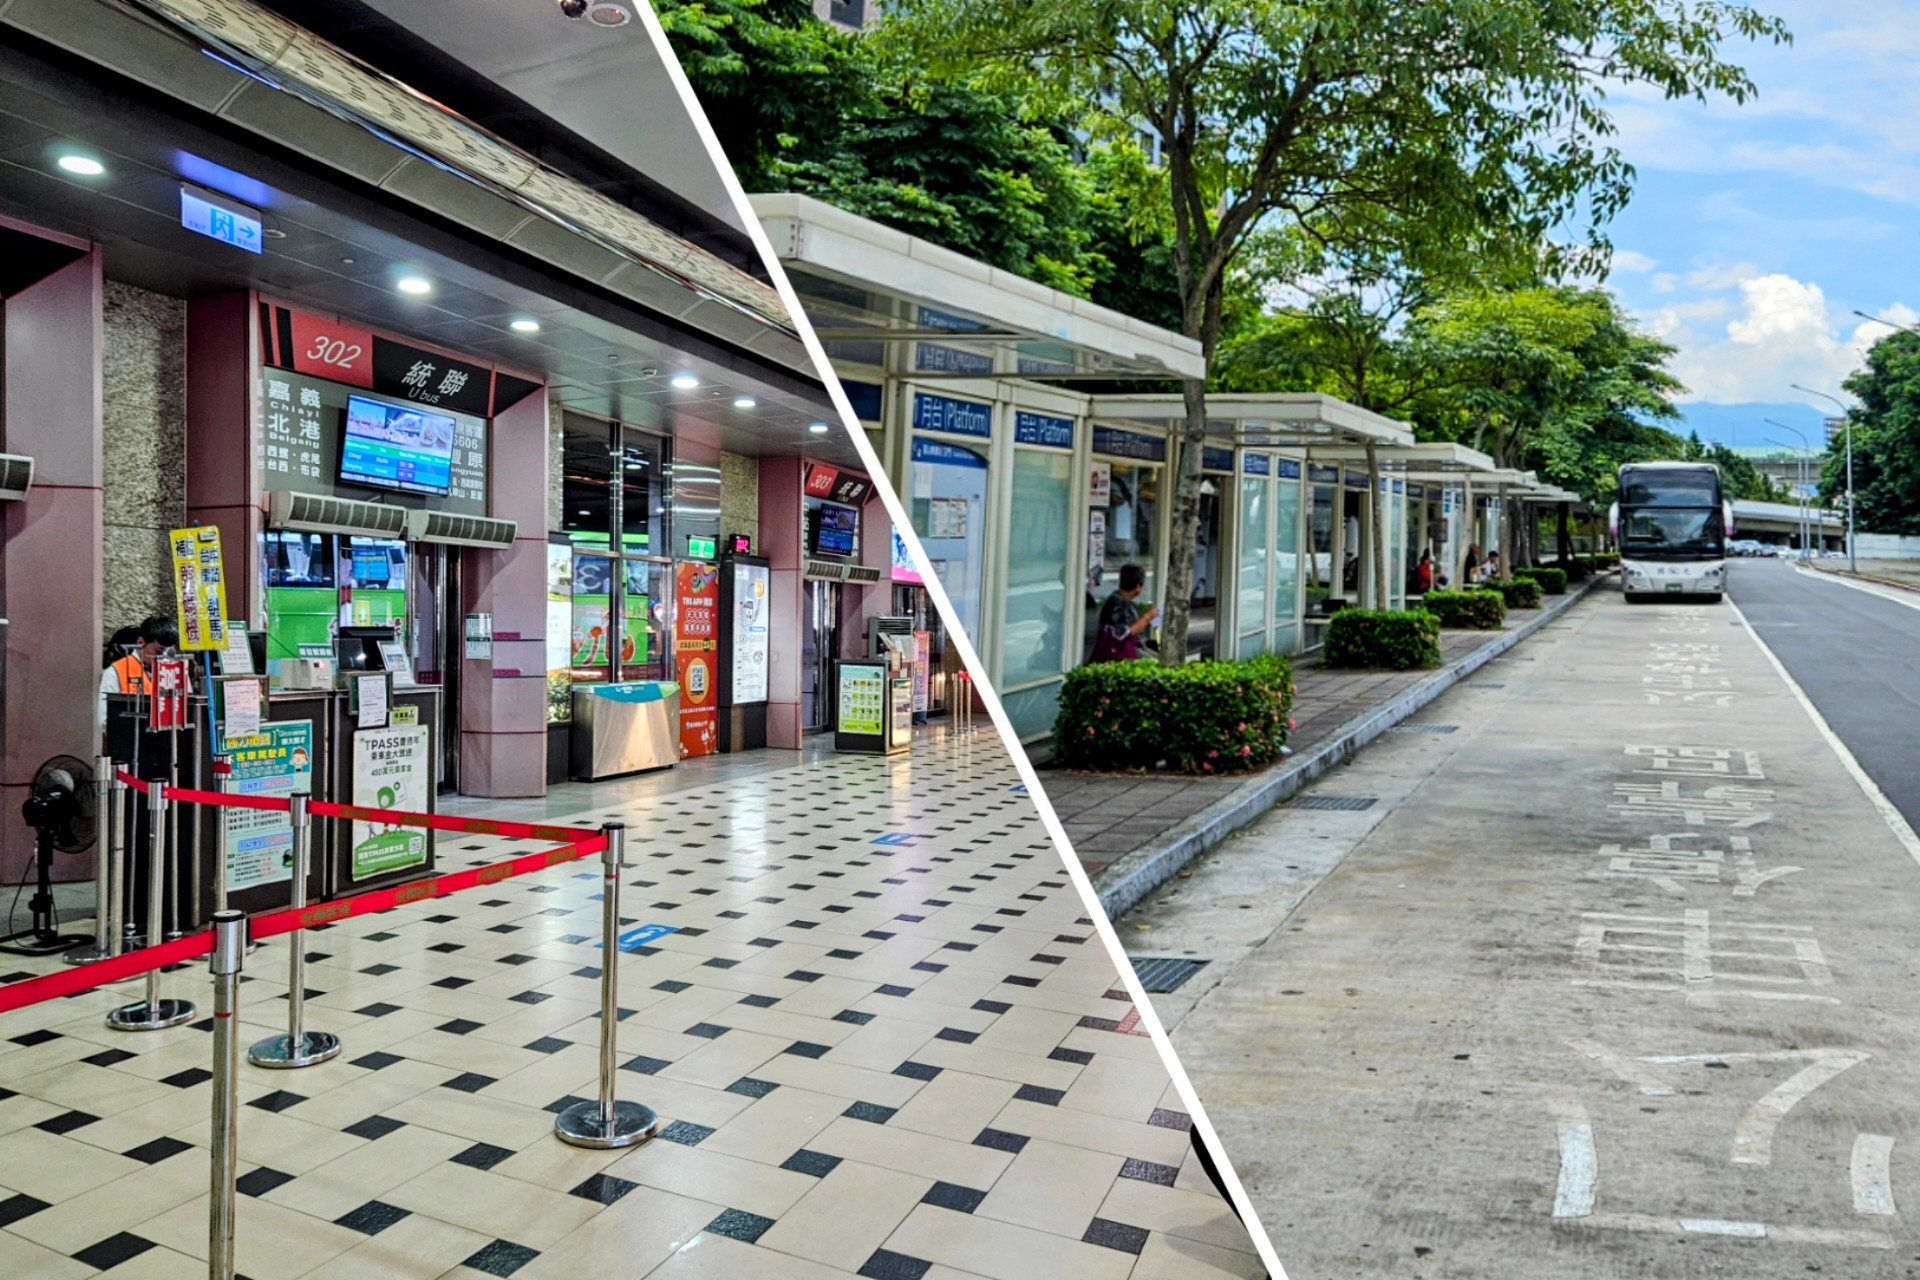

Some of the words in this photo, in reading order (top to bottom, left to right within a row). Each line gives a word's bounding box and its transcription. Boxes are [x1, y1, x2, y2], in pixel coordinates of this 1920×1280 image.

[306, 335, 362, 369] 302
[401, 360, 469, 397] 統聯
[268, 379, 320, 408] 嘉義
[408, 386, 420, 398] U
[419, 388, 441, 404] bus
[270, 400, 319, 418] Chiayi
[922, 397, 943, 429] 月台
[268, 412, 320, 441] 北港
[269, 431, 320, 449] Beigang
[810, 474, 832, 490] 303
[231, 748, 287, 763] 客車駕駛員
